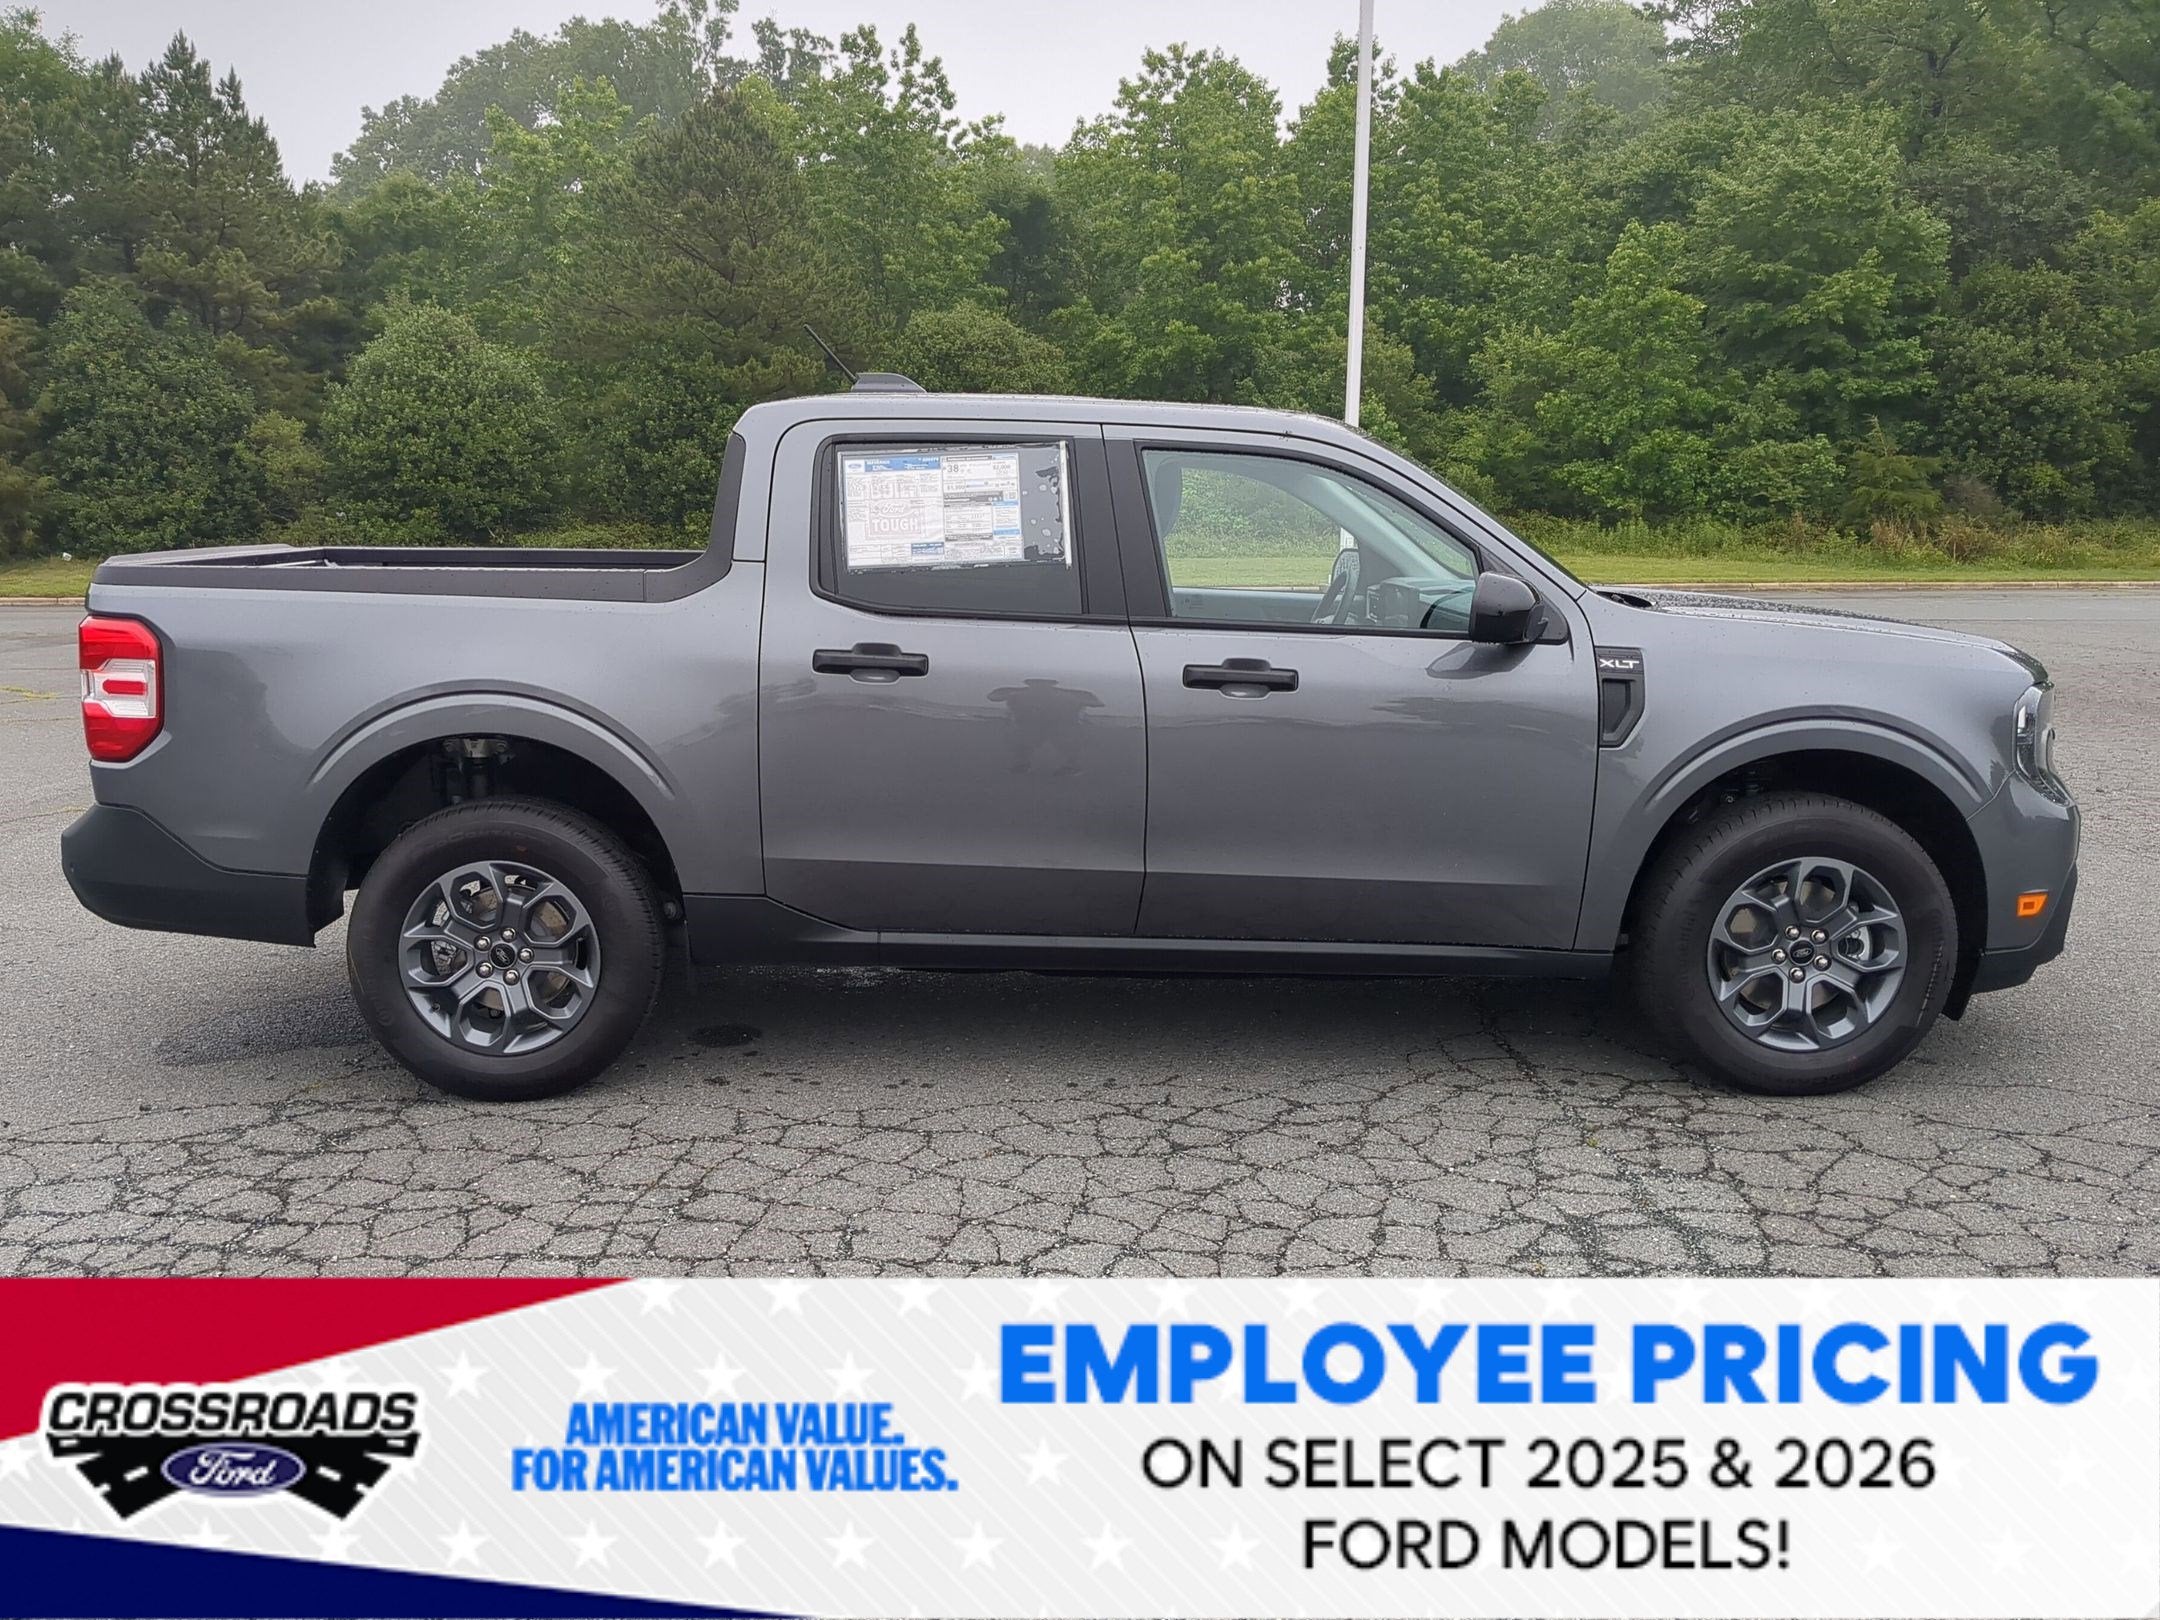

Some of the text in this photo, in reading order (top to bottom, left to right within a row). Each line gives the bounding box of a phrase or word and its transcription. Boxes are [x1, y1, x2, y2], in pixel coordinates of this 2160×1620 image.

[947, 464, 959, 473] 38
[872, 518, 919, 532] TOUGH
[1599, 658, 1640, 669] XLT
